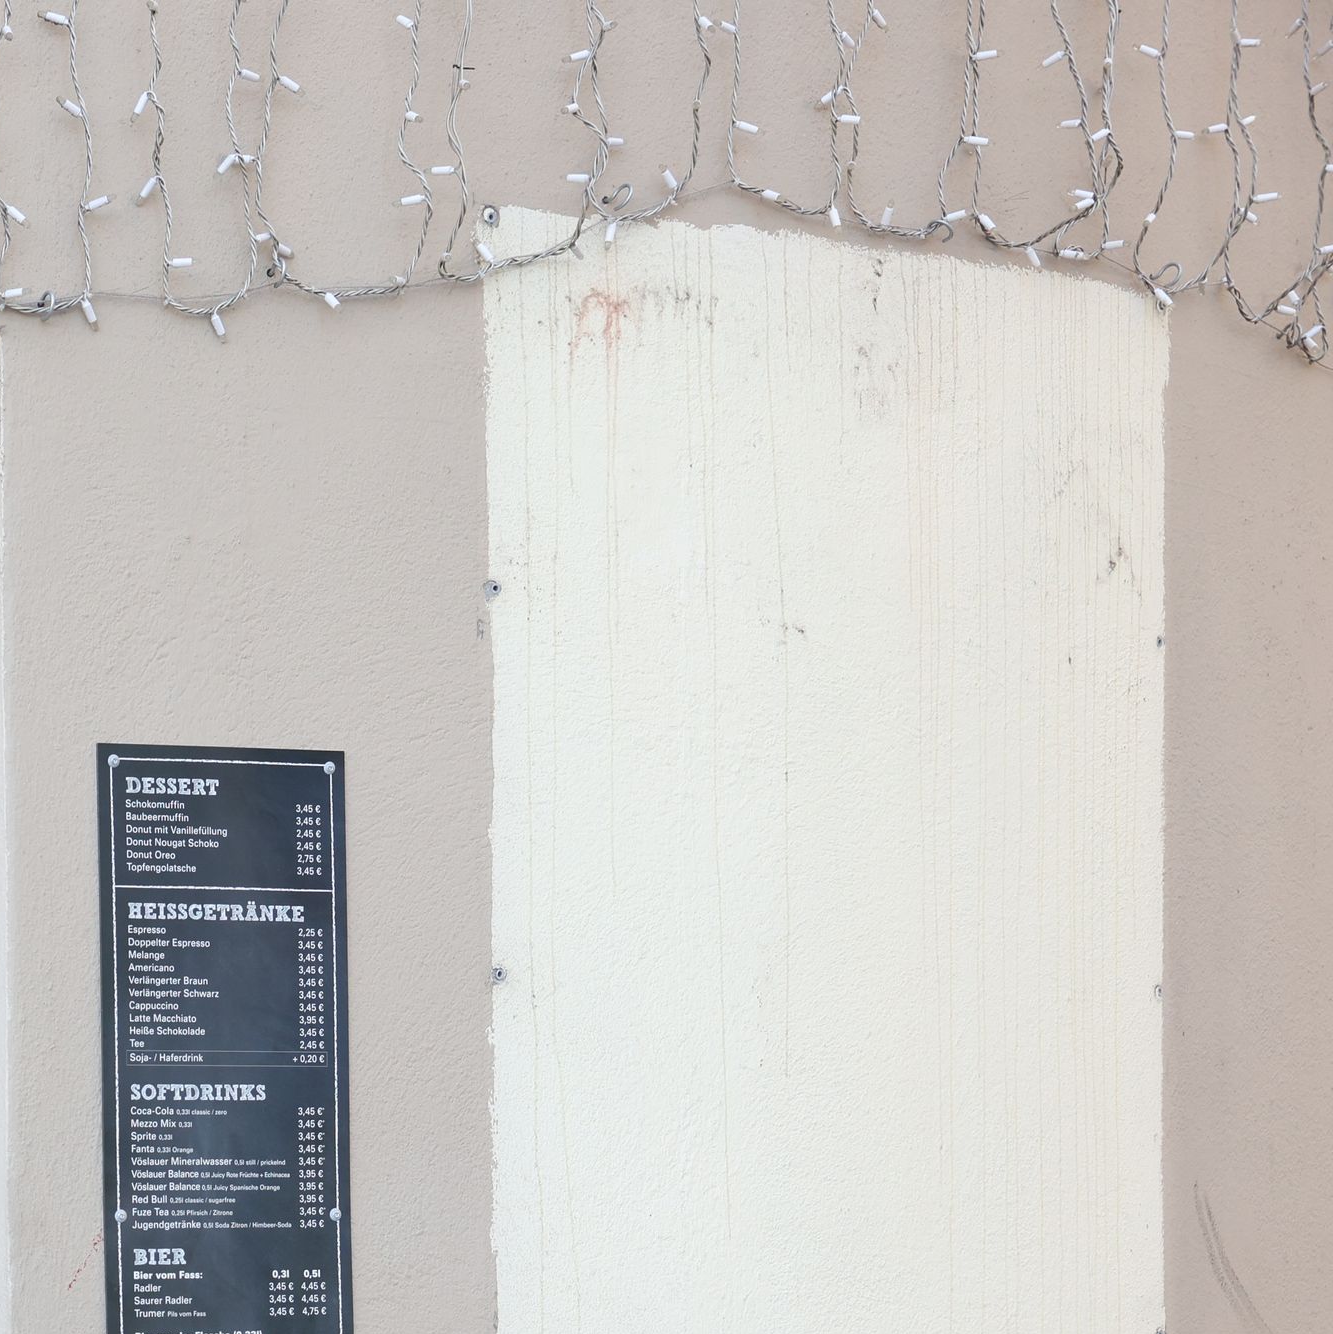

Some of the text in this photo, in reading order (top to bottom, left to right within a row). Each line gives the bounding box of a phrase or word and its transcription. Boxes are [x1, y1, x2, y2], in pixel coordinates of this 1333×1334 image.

[125, 776, 220, 796] DESSERT
[125, 798, 185, 809] Schokomuffin
[295, 804, 314, 814] 3,45
[125, 824, 152, 834] Donut
[154, 825, 168, 834] mit
[170, 825, 228, 838] Vanillefüllung
[296, 829, 314, 839] 2,45
[126, 836, 152, 847] Donut
[154, 837, 186, 849] Nougat
[188, 838, 219, 848] Schoko
[296, 841, 314, 851] 2,45
[127, 901, 305, 923] HEISSGETRÄNKE
[127, 924, 166, 935] Espresso
[298, 928, 316, 938] 2,25
[128, 962, 175, 972] Americano
[298, 965, 316, 975] 3,45
[128, 988, 182, 999] Verlängerter
[183, 988, 219, 998] Schwarz
[298, 990, 317, 1000] 3,45
[129, 1013, 151, 1023] Latte
[153, 1013, 197, 1023] Macchiato
[299, 1015, 317, 1025] 3,95
[129, 1038, 145, 1048] Tee
[299, 1040, 317, 1050] 2,45
[130, 1083, 266, 1101] SOFTDRINKS
[133, 1247, 187, 1266] BIER
[133, 1270, 203, 1280] Bier vom Fass:
[134, 1296, 163, 1306] Saurer
[165, 1295, 193, 1305] Radler
[269, 1294, 287, 1304] 3,45
[301, 1294, 319, 1304] 4,45
